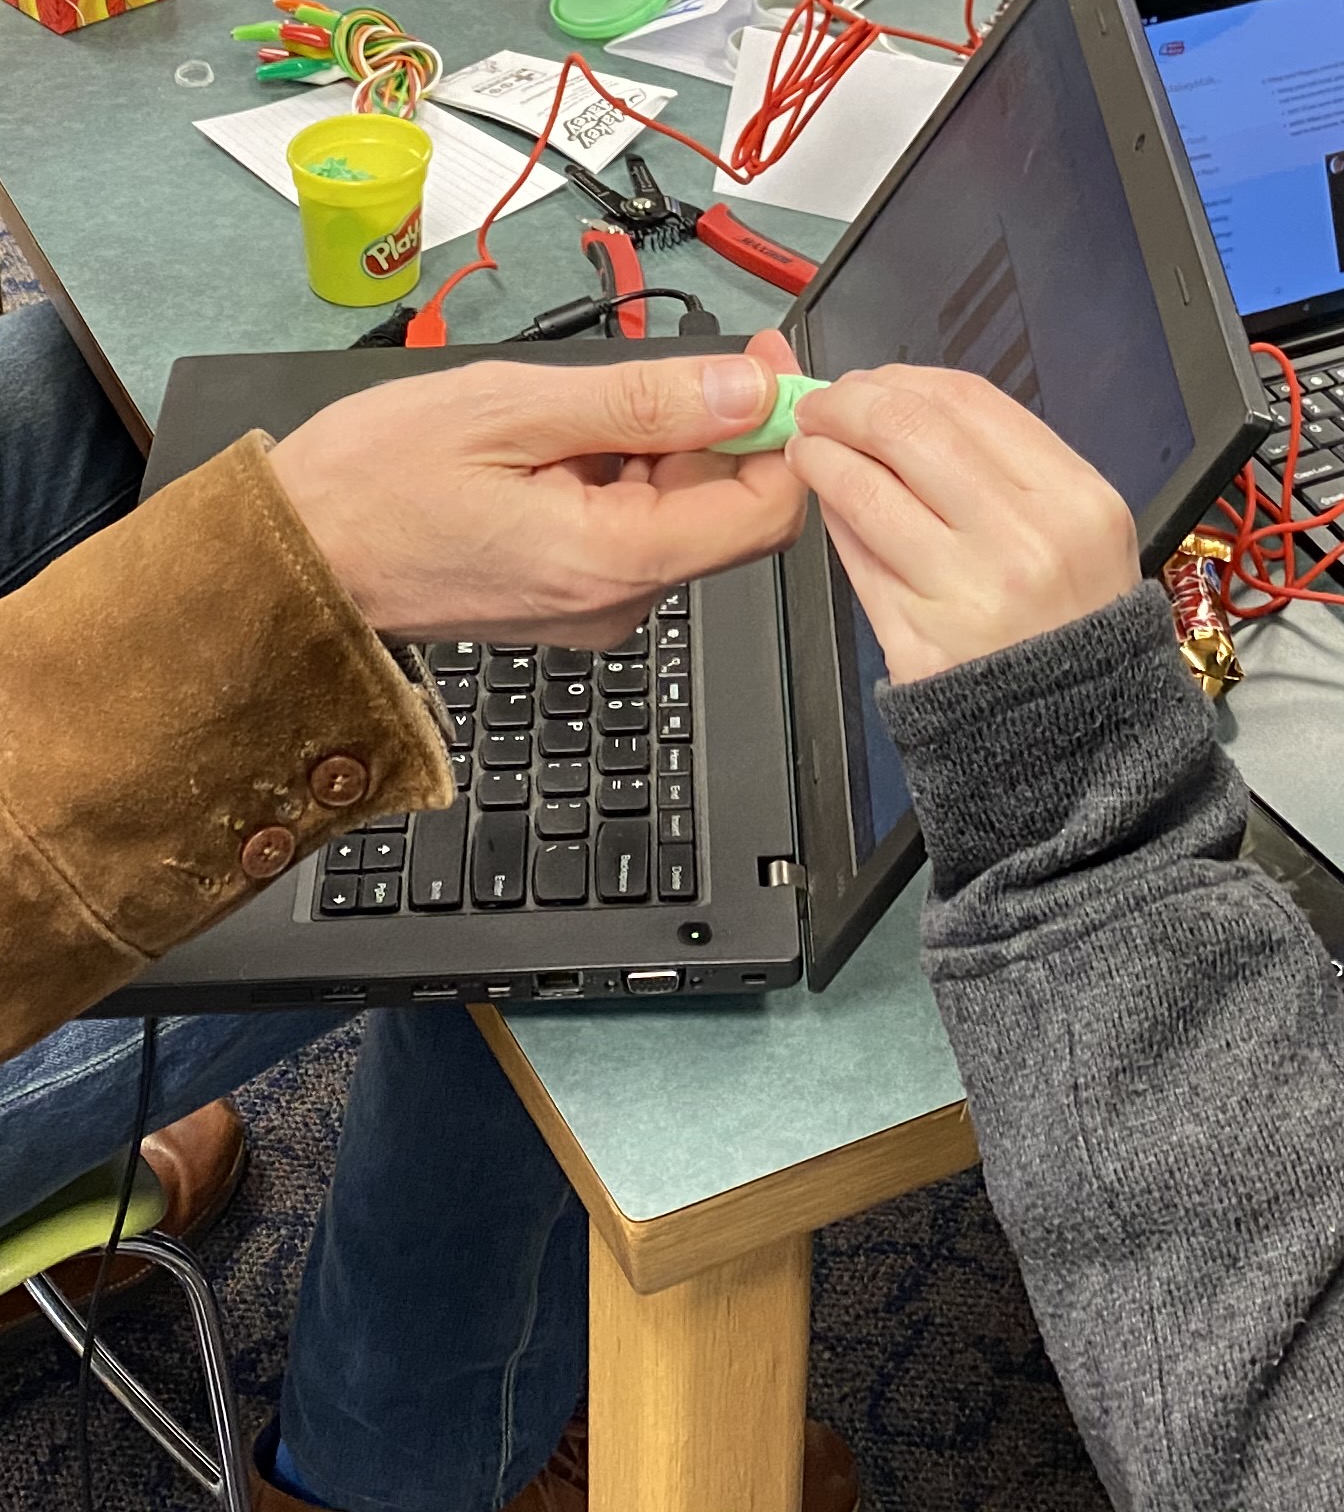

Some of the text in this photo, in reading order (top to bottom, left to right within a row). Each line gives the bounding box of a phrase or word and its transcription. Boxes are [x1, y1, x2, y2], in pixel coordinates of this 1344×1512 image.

[457, 641, 474, 654] M
[512, 657, 529, 668] K
[608, 662, 624, 672] 9
[509, 694, 527, 704] L
[567, 682, 585, 731] O P
